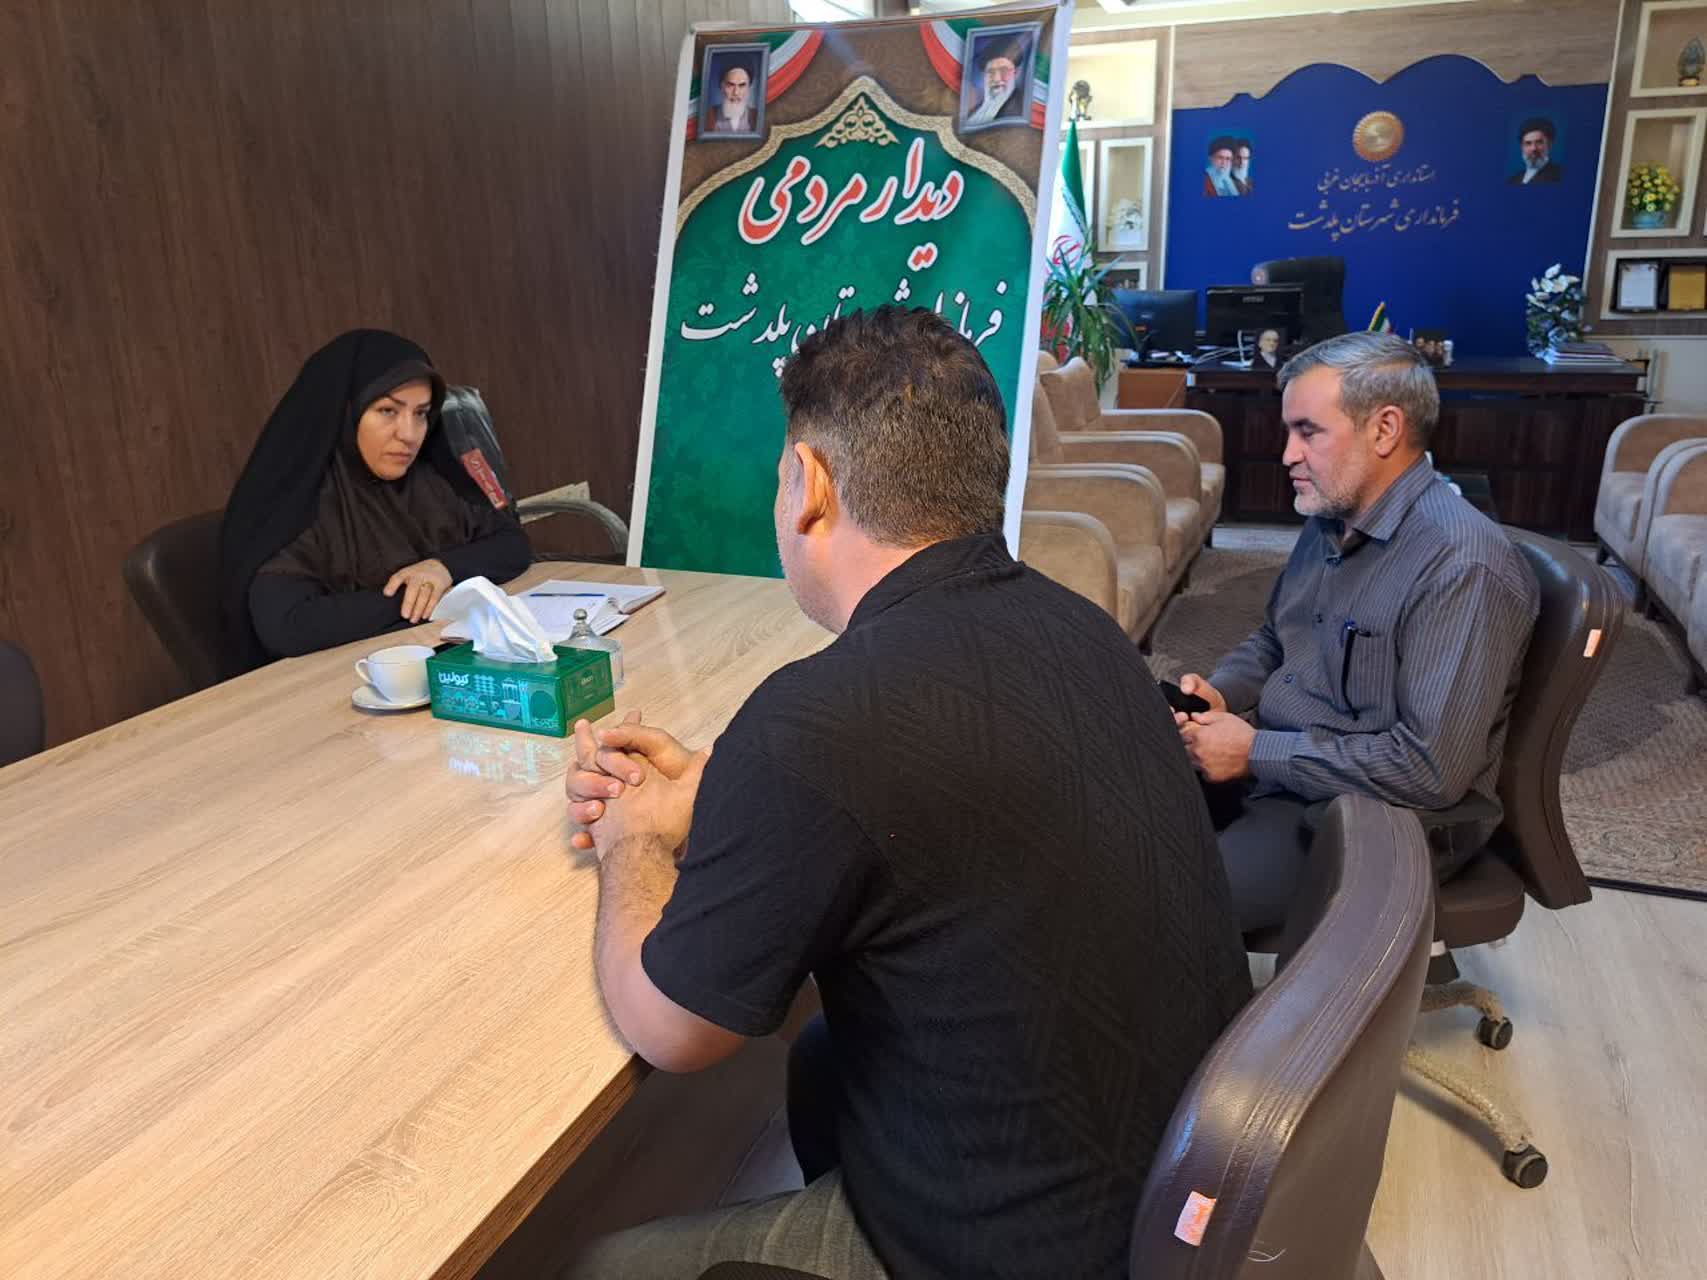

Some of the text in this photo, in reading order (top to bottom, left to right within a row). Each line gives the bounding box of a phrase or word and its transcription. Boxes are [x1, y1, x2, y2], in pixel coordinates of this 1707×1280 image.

[738, 137, 965, 271] دیدار مردمی
[1288, 198, 1460, 242] فرمانداری شهرستان پلدشت
[681, 272, 792, 377] پلدشت
